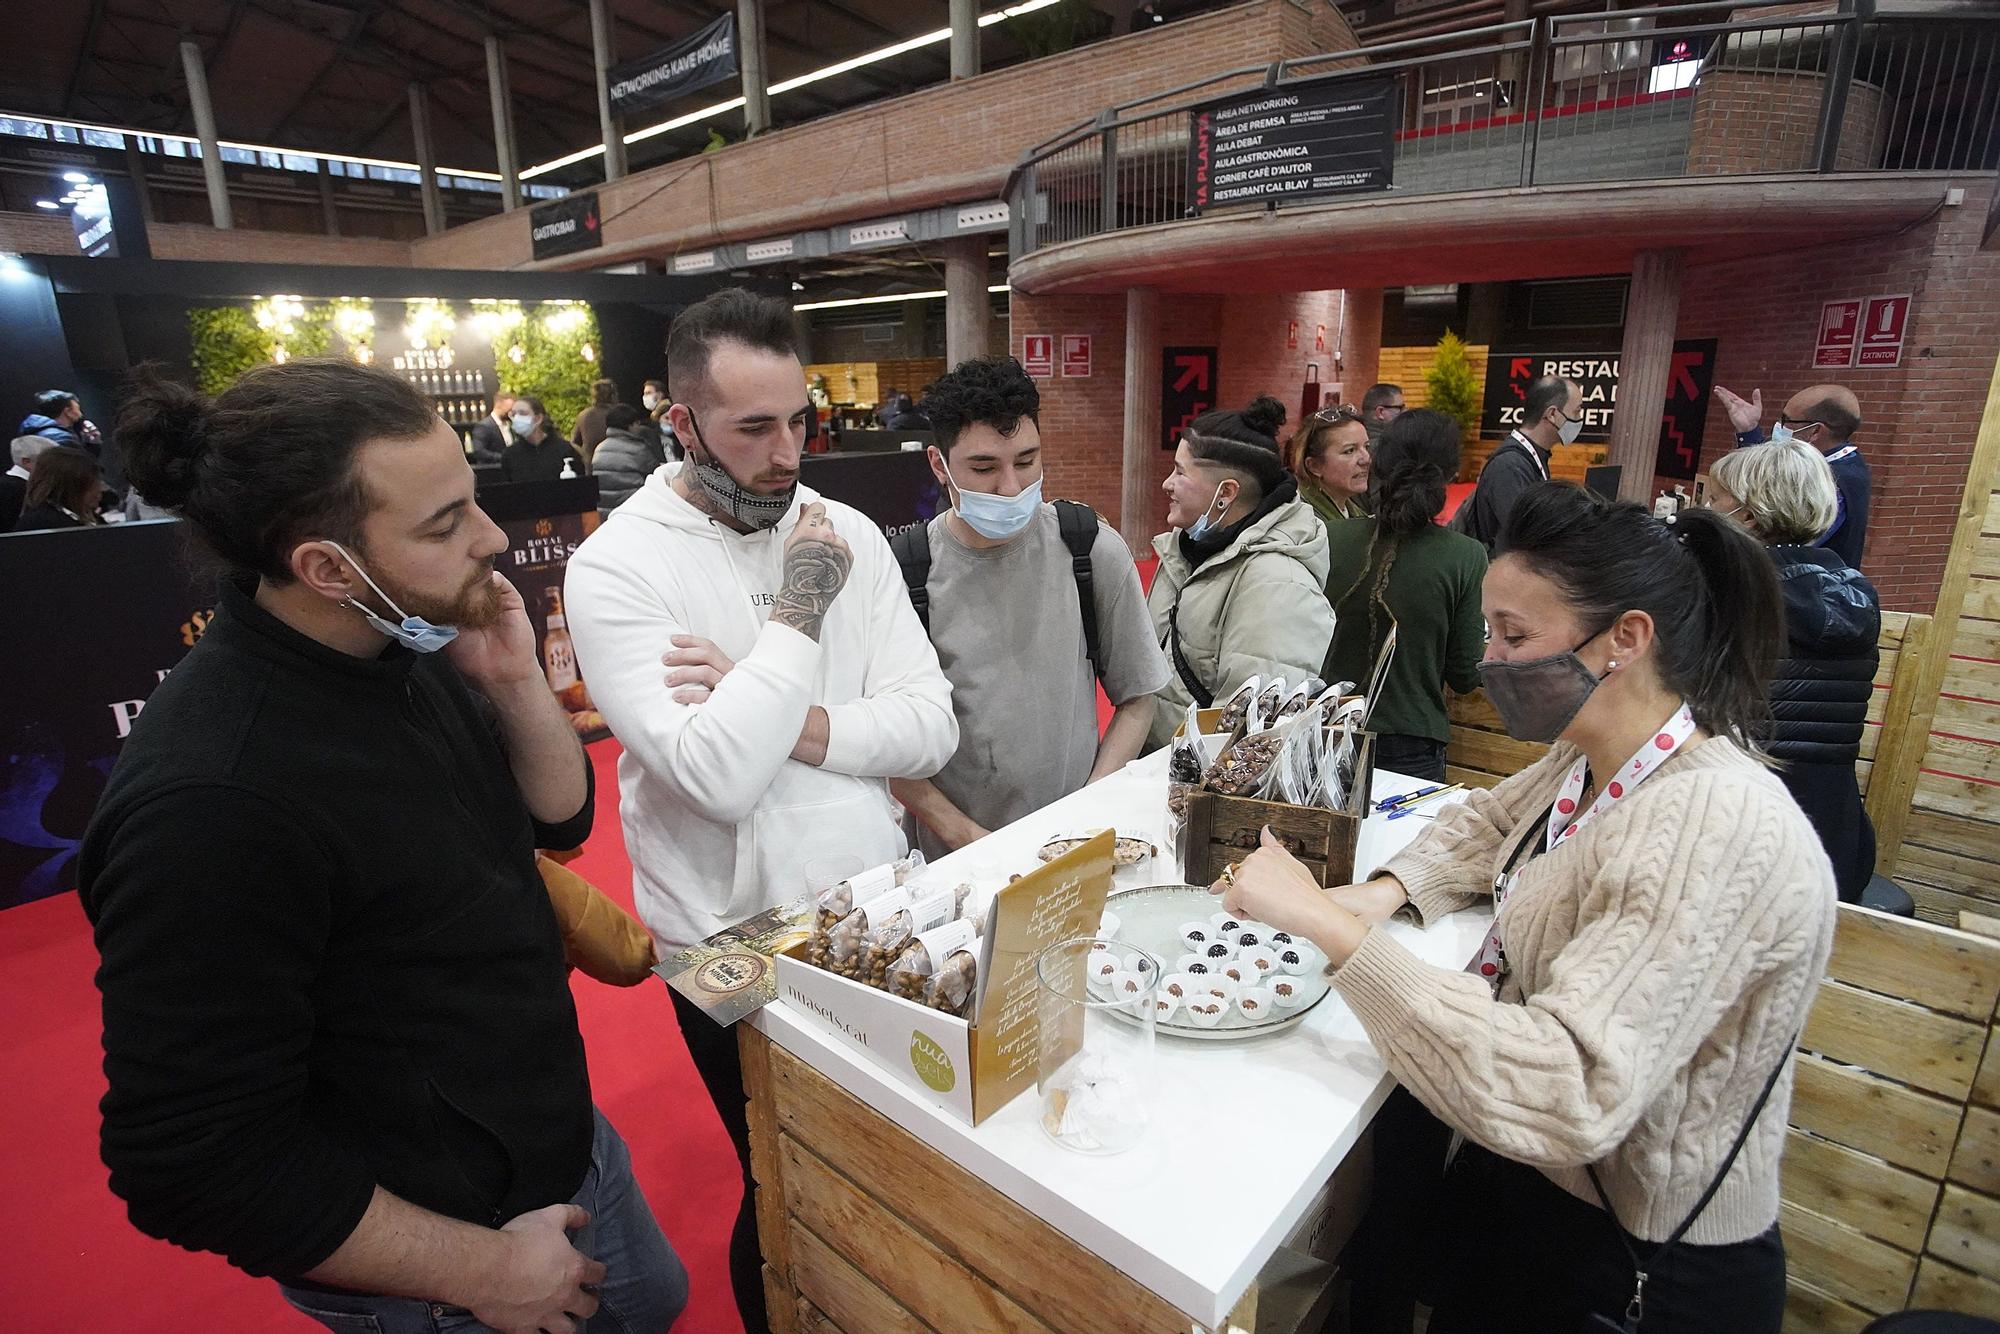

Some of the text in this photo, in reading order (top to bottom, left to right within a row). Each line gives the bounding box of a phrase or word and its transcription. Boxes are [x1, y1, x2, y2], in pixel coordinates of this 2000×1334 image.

[610, 37, 731, 100] NETWORKING KAVE HOME
[1238, 96, 1299, 114] NETWORKING
[1237, 123, 1249, 133] DE
[1250, 116, 1286, 130] PREMSA
[1215, 135, 1263, 153] AULA DEBAT
[1214, 146, 1308, 169] AULA GASTRONÒMICA
[1214, 163, 1312, 185] CORNER CAFÈ D'AUTOR
[1214, 180, 1309, 200] RESTAURANT CAL BLAY
[533, 219, 576, 241] GASTROBAR
[1862, 351, 1896, 359] EXTINTOR
[527, 535, 561, 548] ROYAL
[788, 984, 872, 1048] nuasets.cat
[912, 1036, 952, 1069] nua
